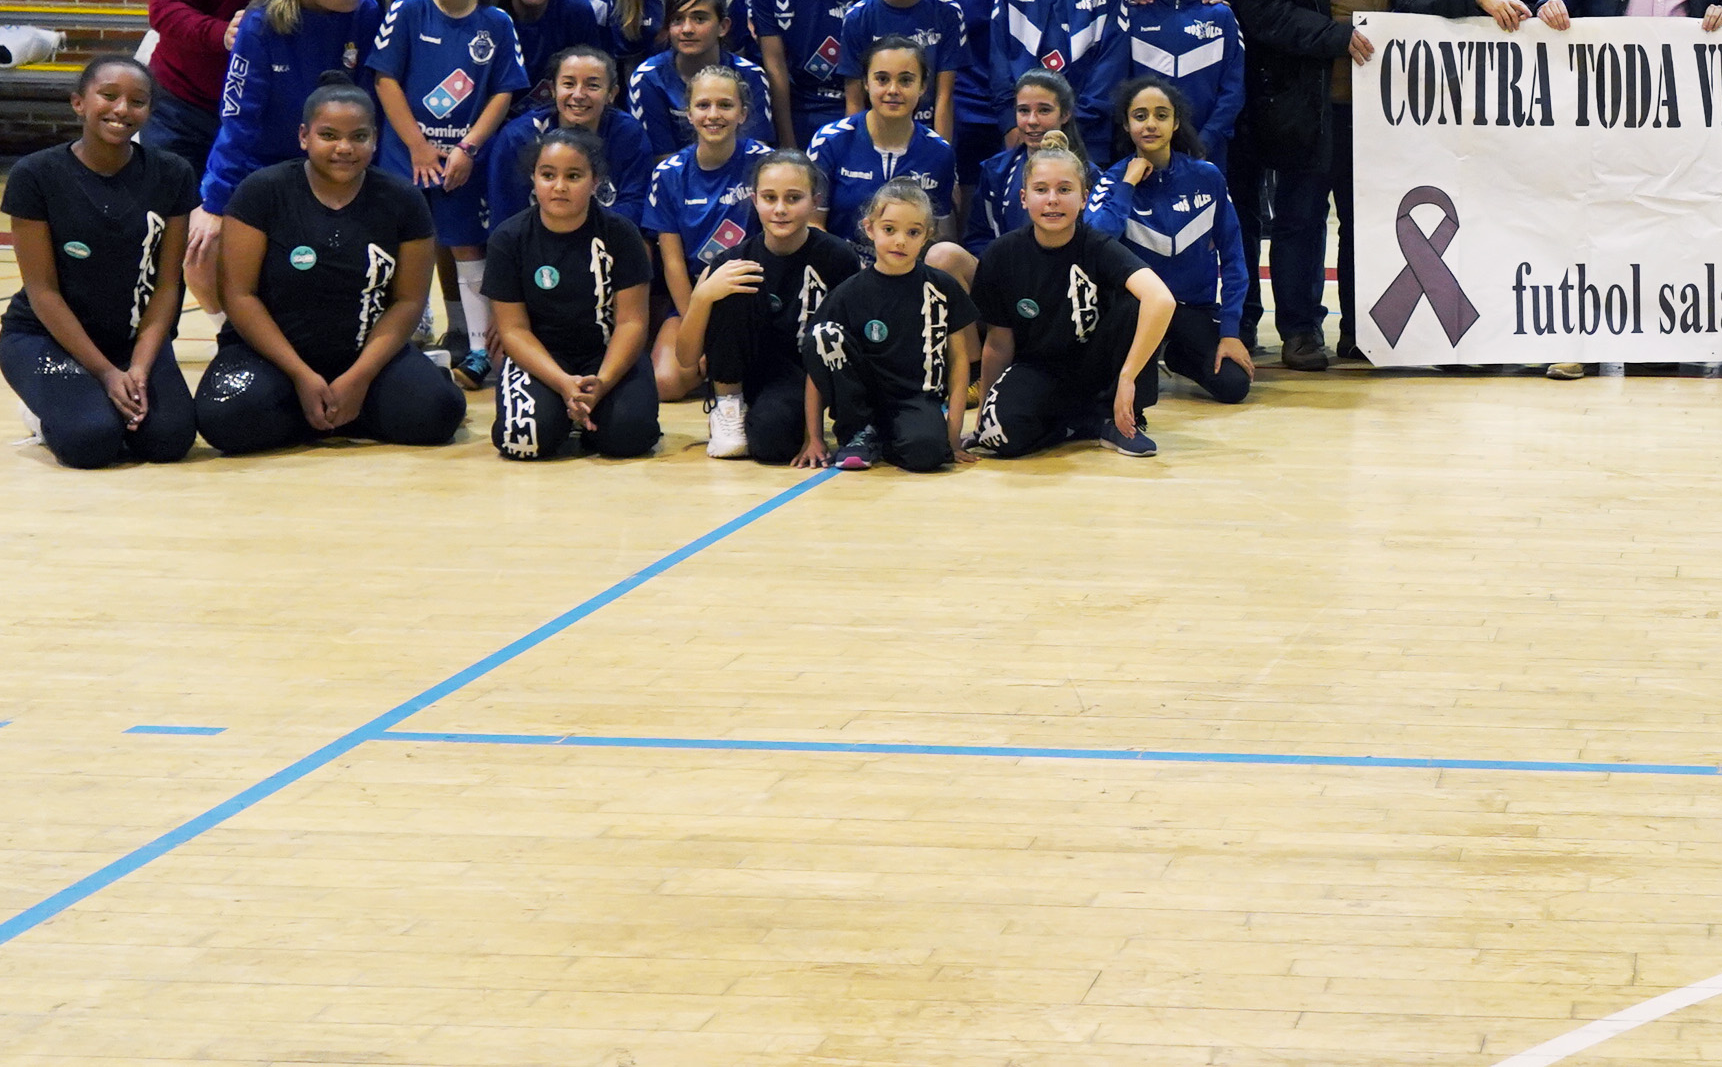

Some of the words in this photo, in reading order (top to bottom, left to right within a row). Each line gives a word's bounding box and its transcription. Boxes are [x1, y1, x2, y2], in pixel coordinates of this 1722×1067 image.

[1380, 39, 1555, 128] CONTRA
[1568, 42, 1682, 129] TODA
[841, 167, 873, 181] hummel
[1512, 261, 1642, 336] futbol
